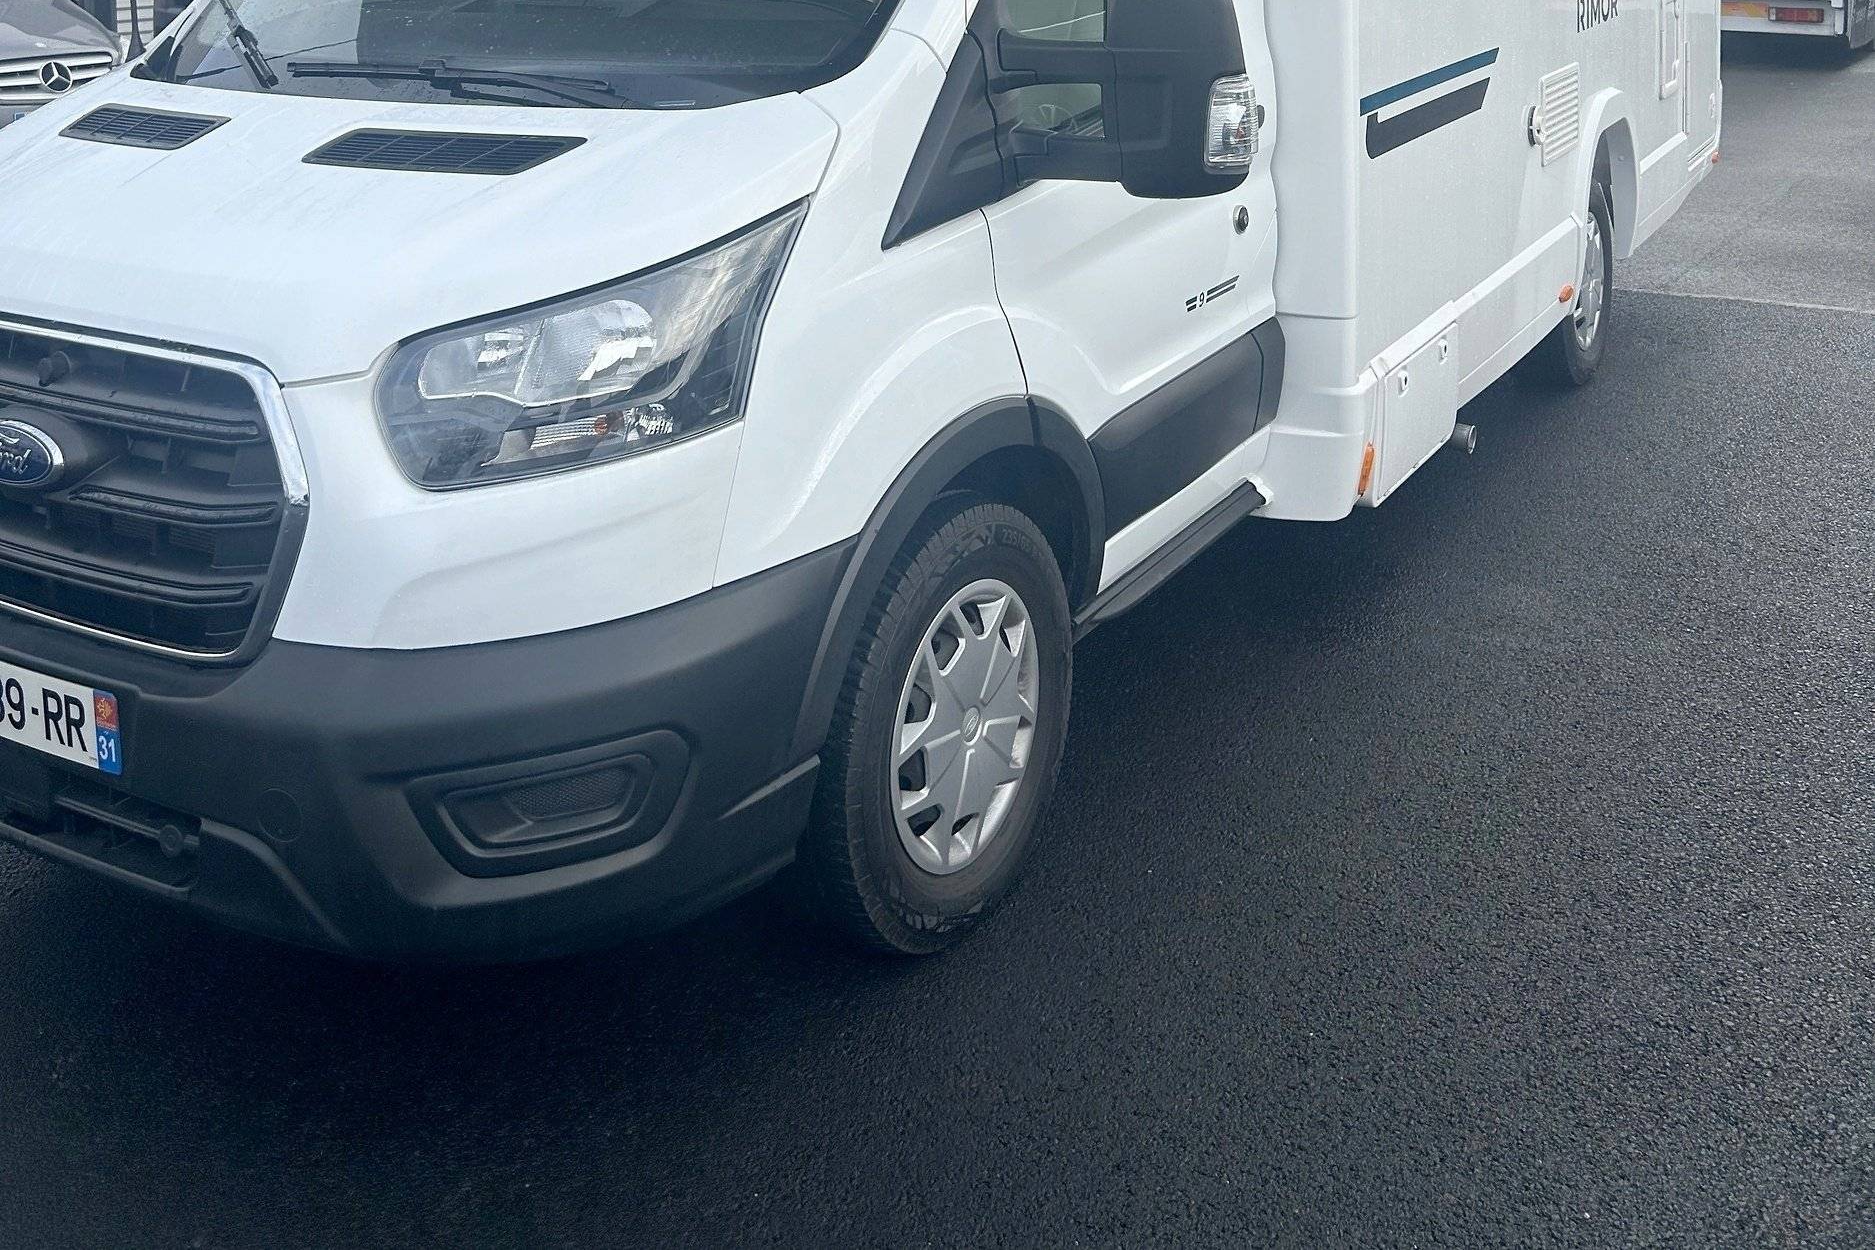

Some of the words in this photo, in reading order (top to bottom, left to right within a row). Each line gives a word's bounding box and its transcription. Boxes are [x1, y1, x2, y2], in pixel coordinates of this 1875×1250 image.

[1198, 291, 1205, 308] 9
[0, 676, 89, 753] 9-RR
[98, 735, 116, 763] 31
